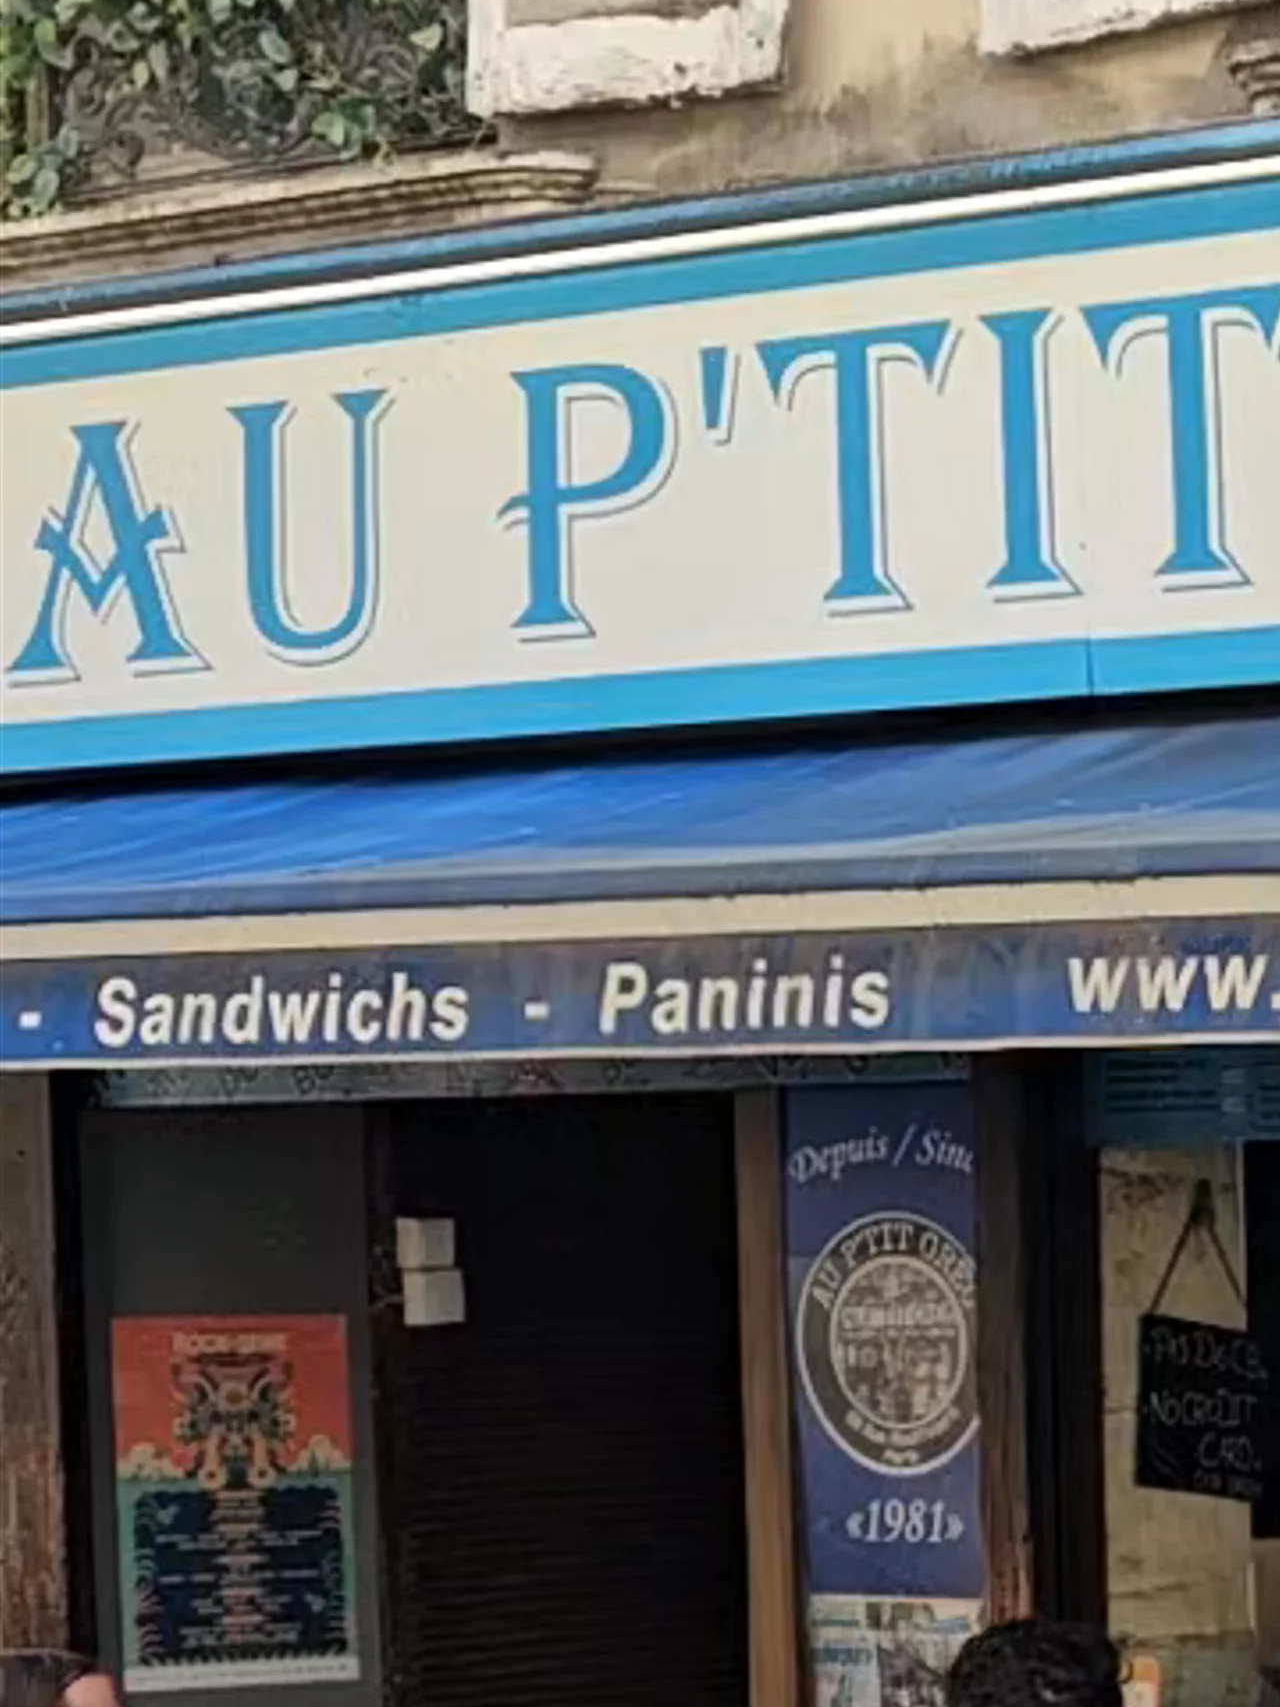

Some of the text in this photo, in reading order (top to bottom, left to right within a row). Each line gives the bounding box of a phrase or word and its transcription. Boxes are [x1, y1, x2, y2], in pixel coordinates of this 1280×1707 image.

[5, 385, 399, 686] AU
[94, 972, 469, 1048] Sandwichs
[600, 954, 889, 1034] Paninis
[788, 1126, 889, 1182] Depuis
[812, 1262, 842, 1309] AU
